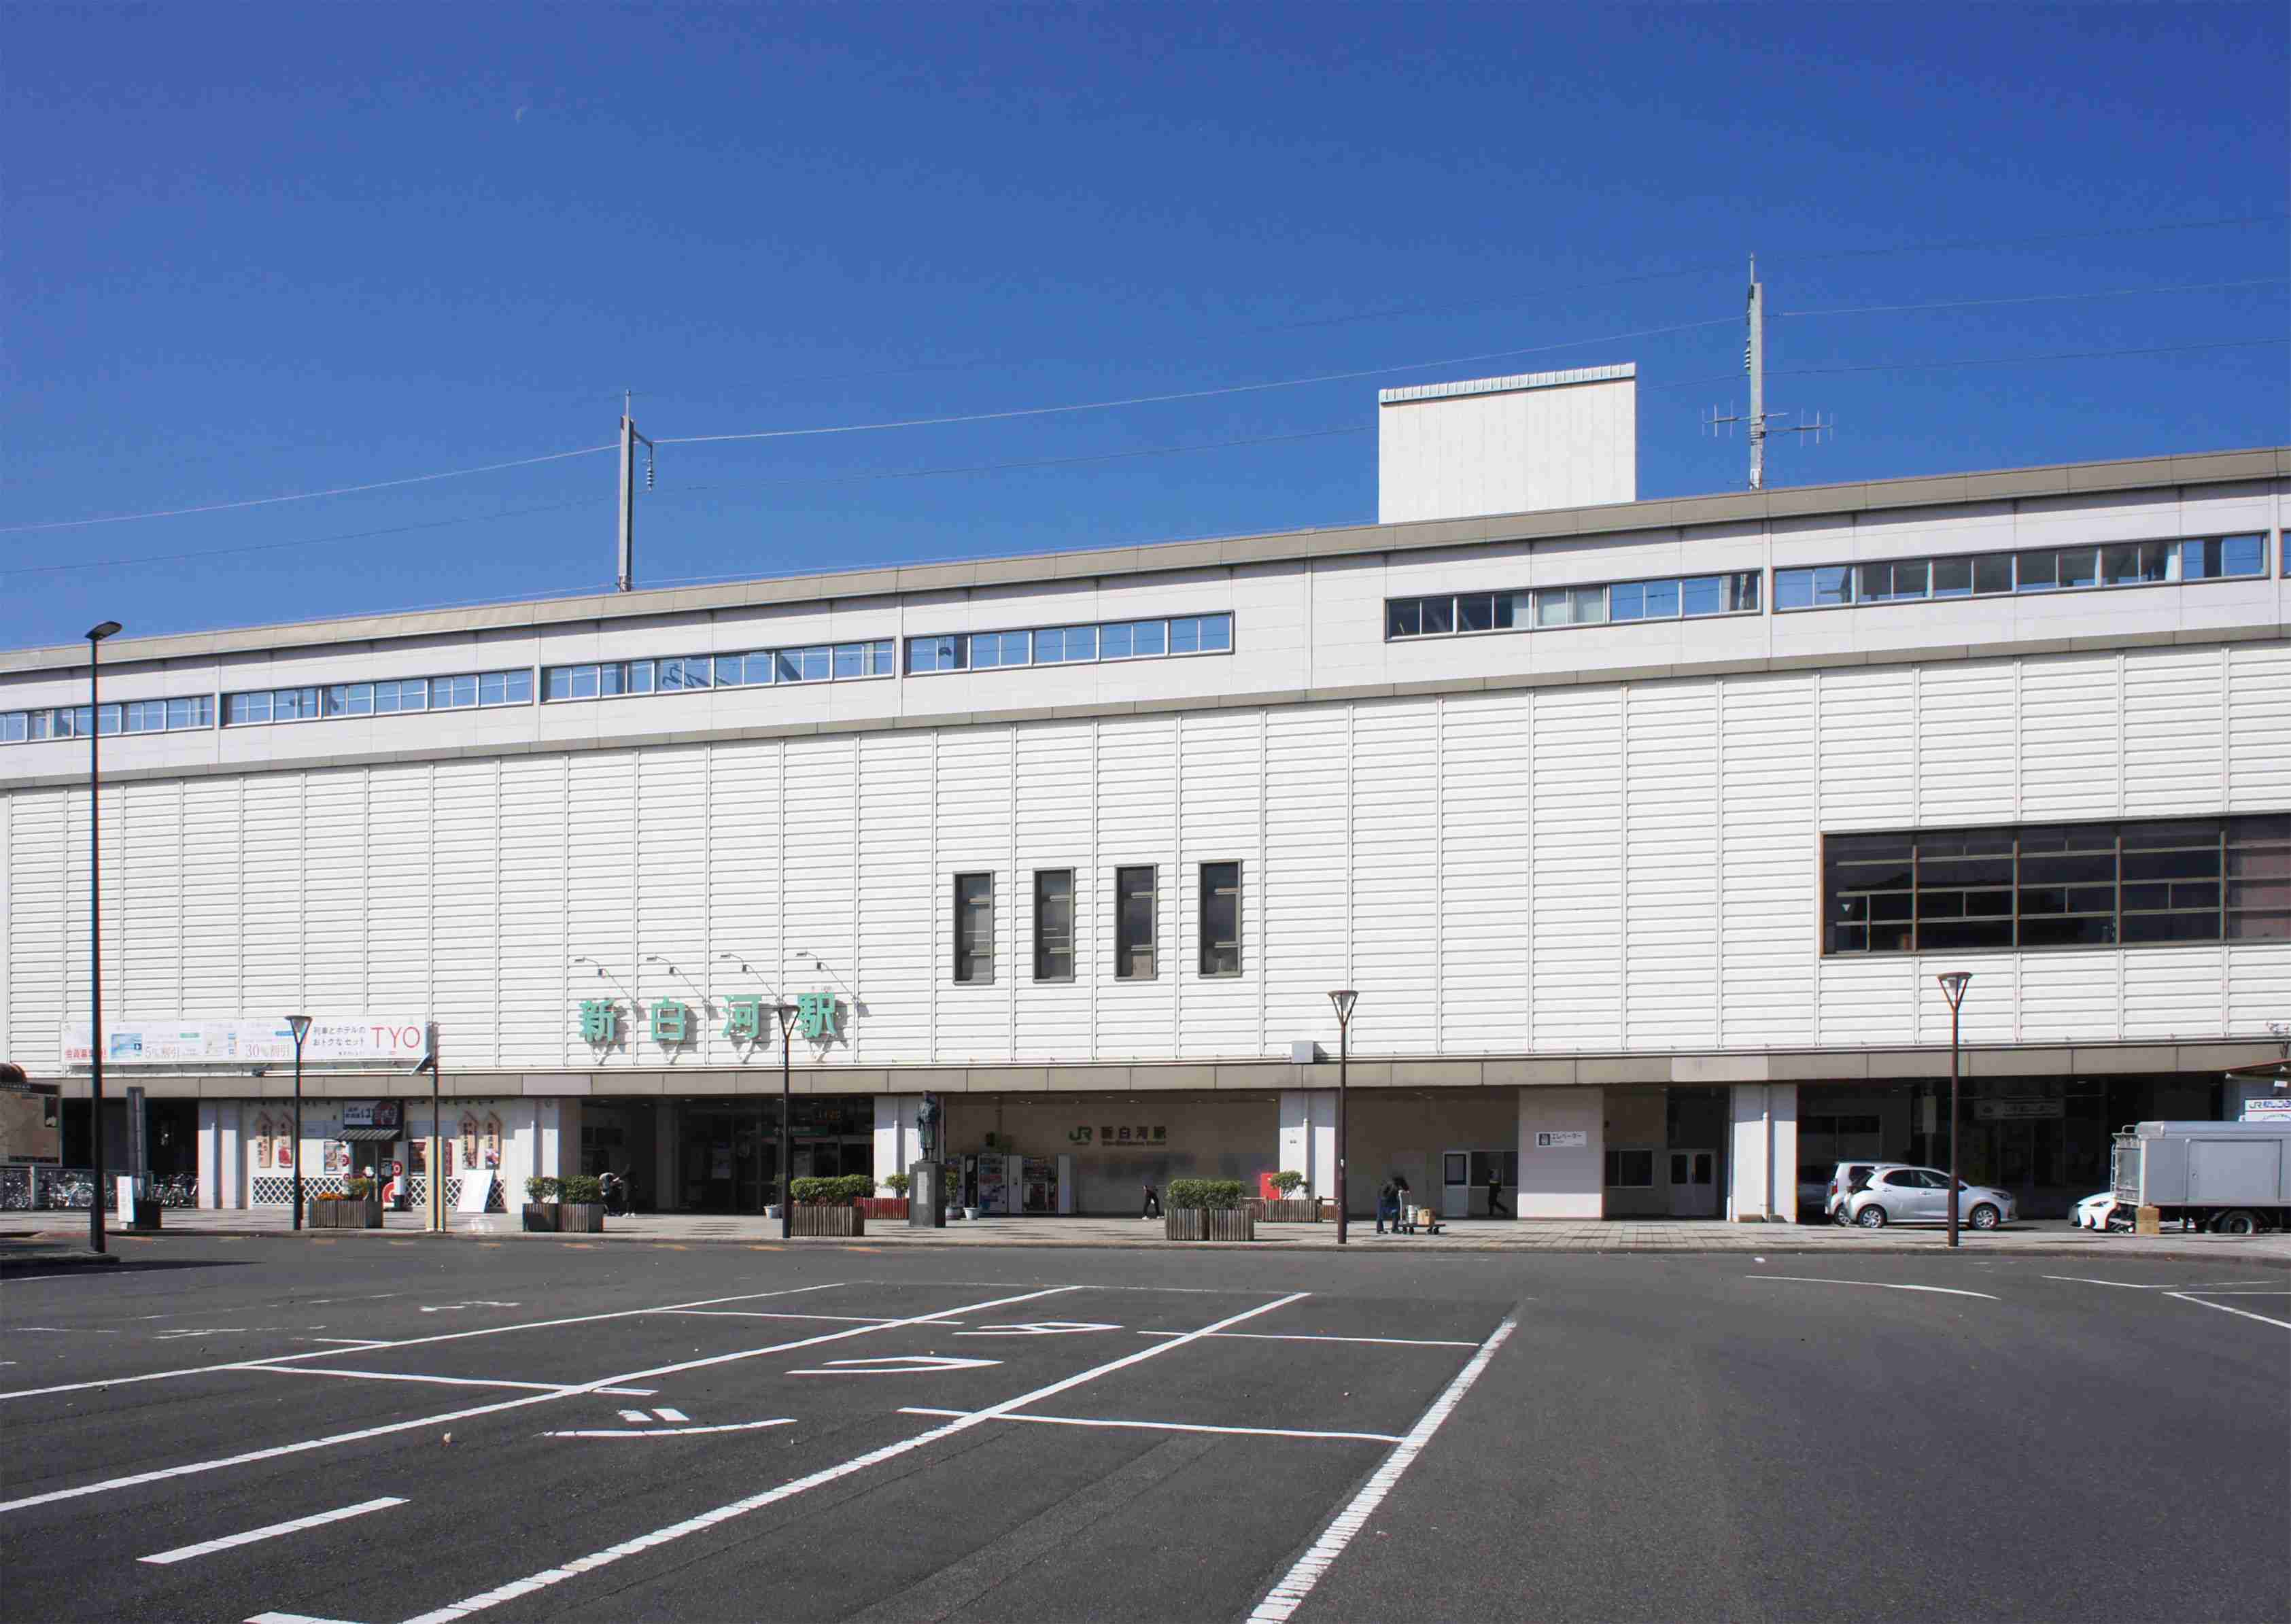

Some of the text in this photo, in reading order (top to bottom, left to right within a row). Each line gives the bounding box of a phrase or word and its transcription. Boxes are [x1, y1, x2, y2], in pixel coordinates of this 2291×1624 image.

[579, 992, 838, 1043] 新白河駅
[371, 1026, 420, 1048] TYO
